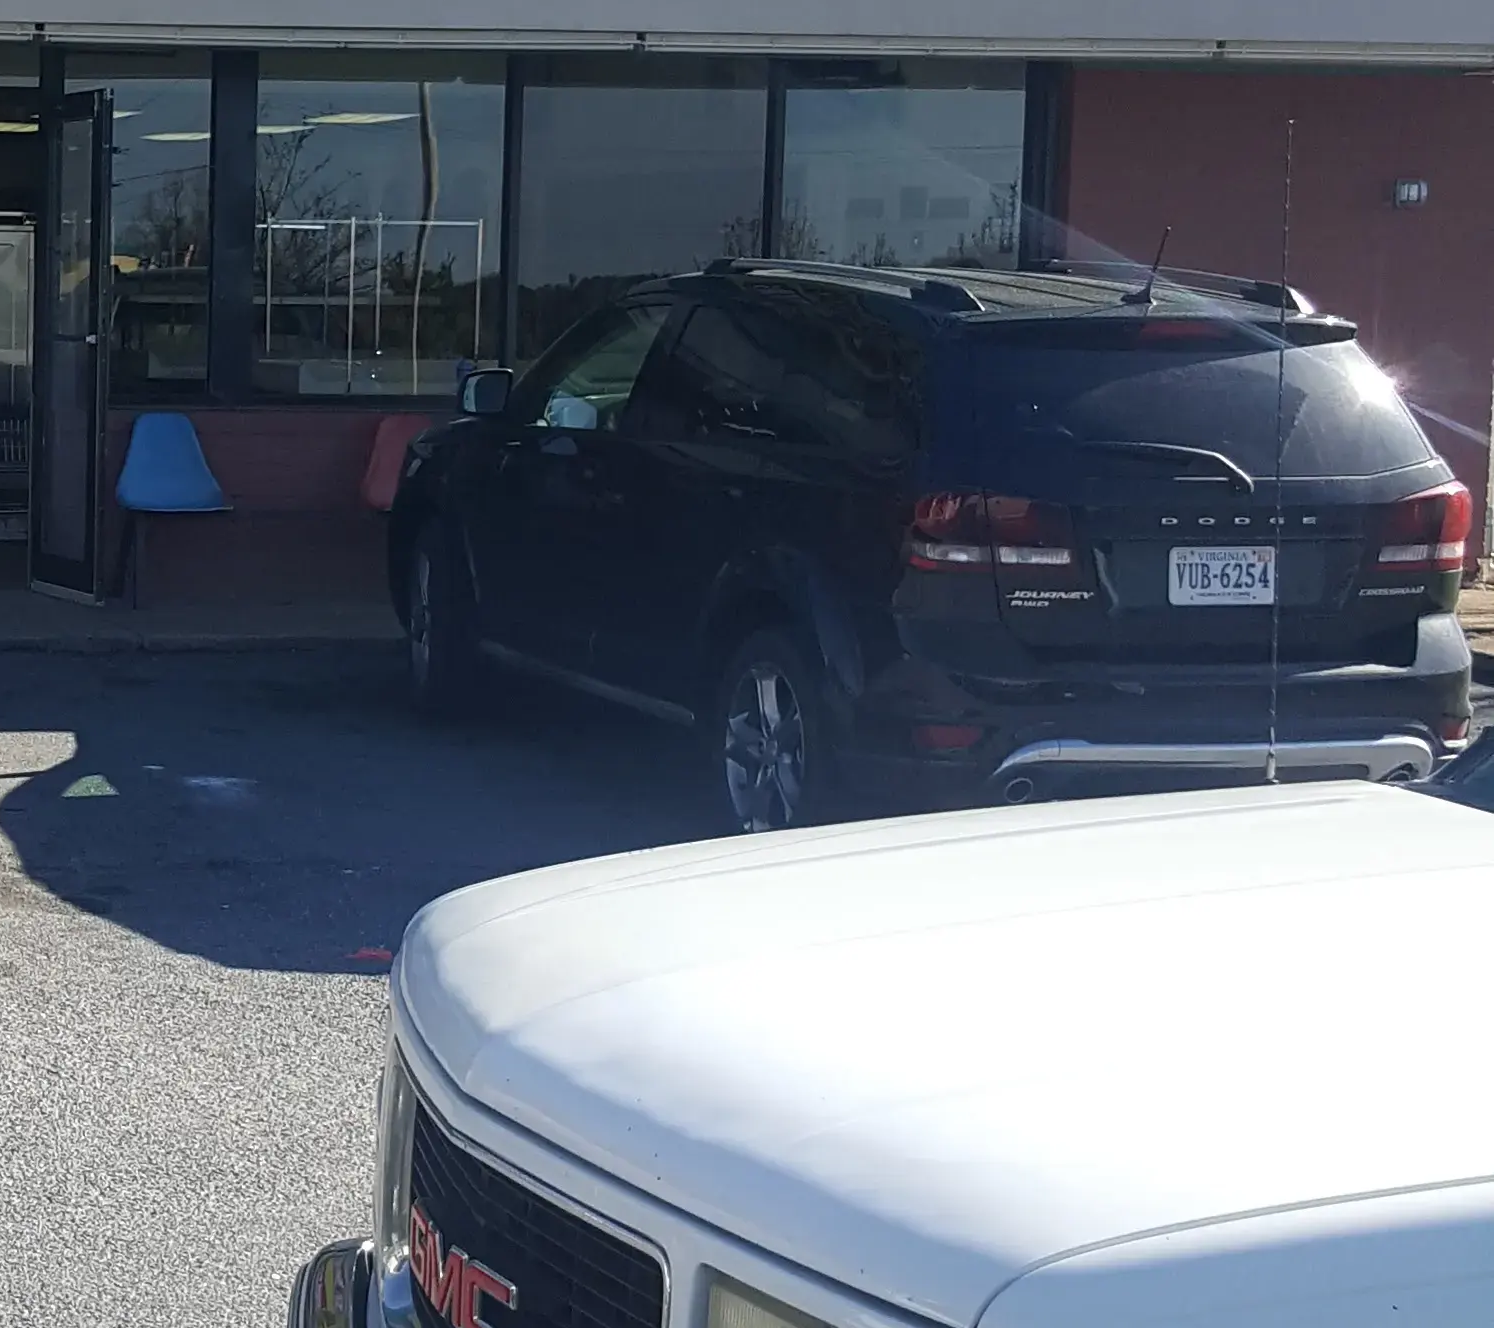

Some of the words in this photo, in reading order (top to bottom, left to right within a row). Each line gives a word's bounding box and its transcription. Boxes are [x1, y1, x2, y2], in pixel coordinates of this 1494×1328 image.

[1161, 516, 1317, 526] DODGE
[1197, 551, 1248, 562] VIRGINIA
[1176, 562, 1270, 590] VUB-6254
[1005, 590, 1095, 600] JOURNEY
